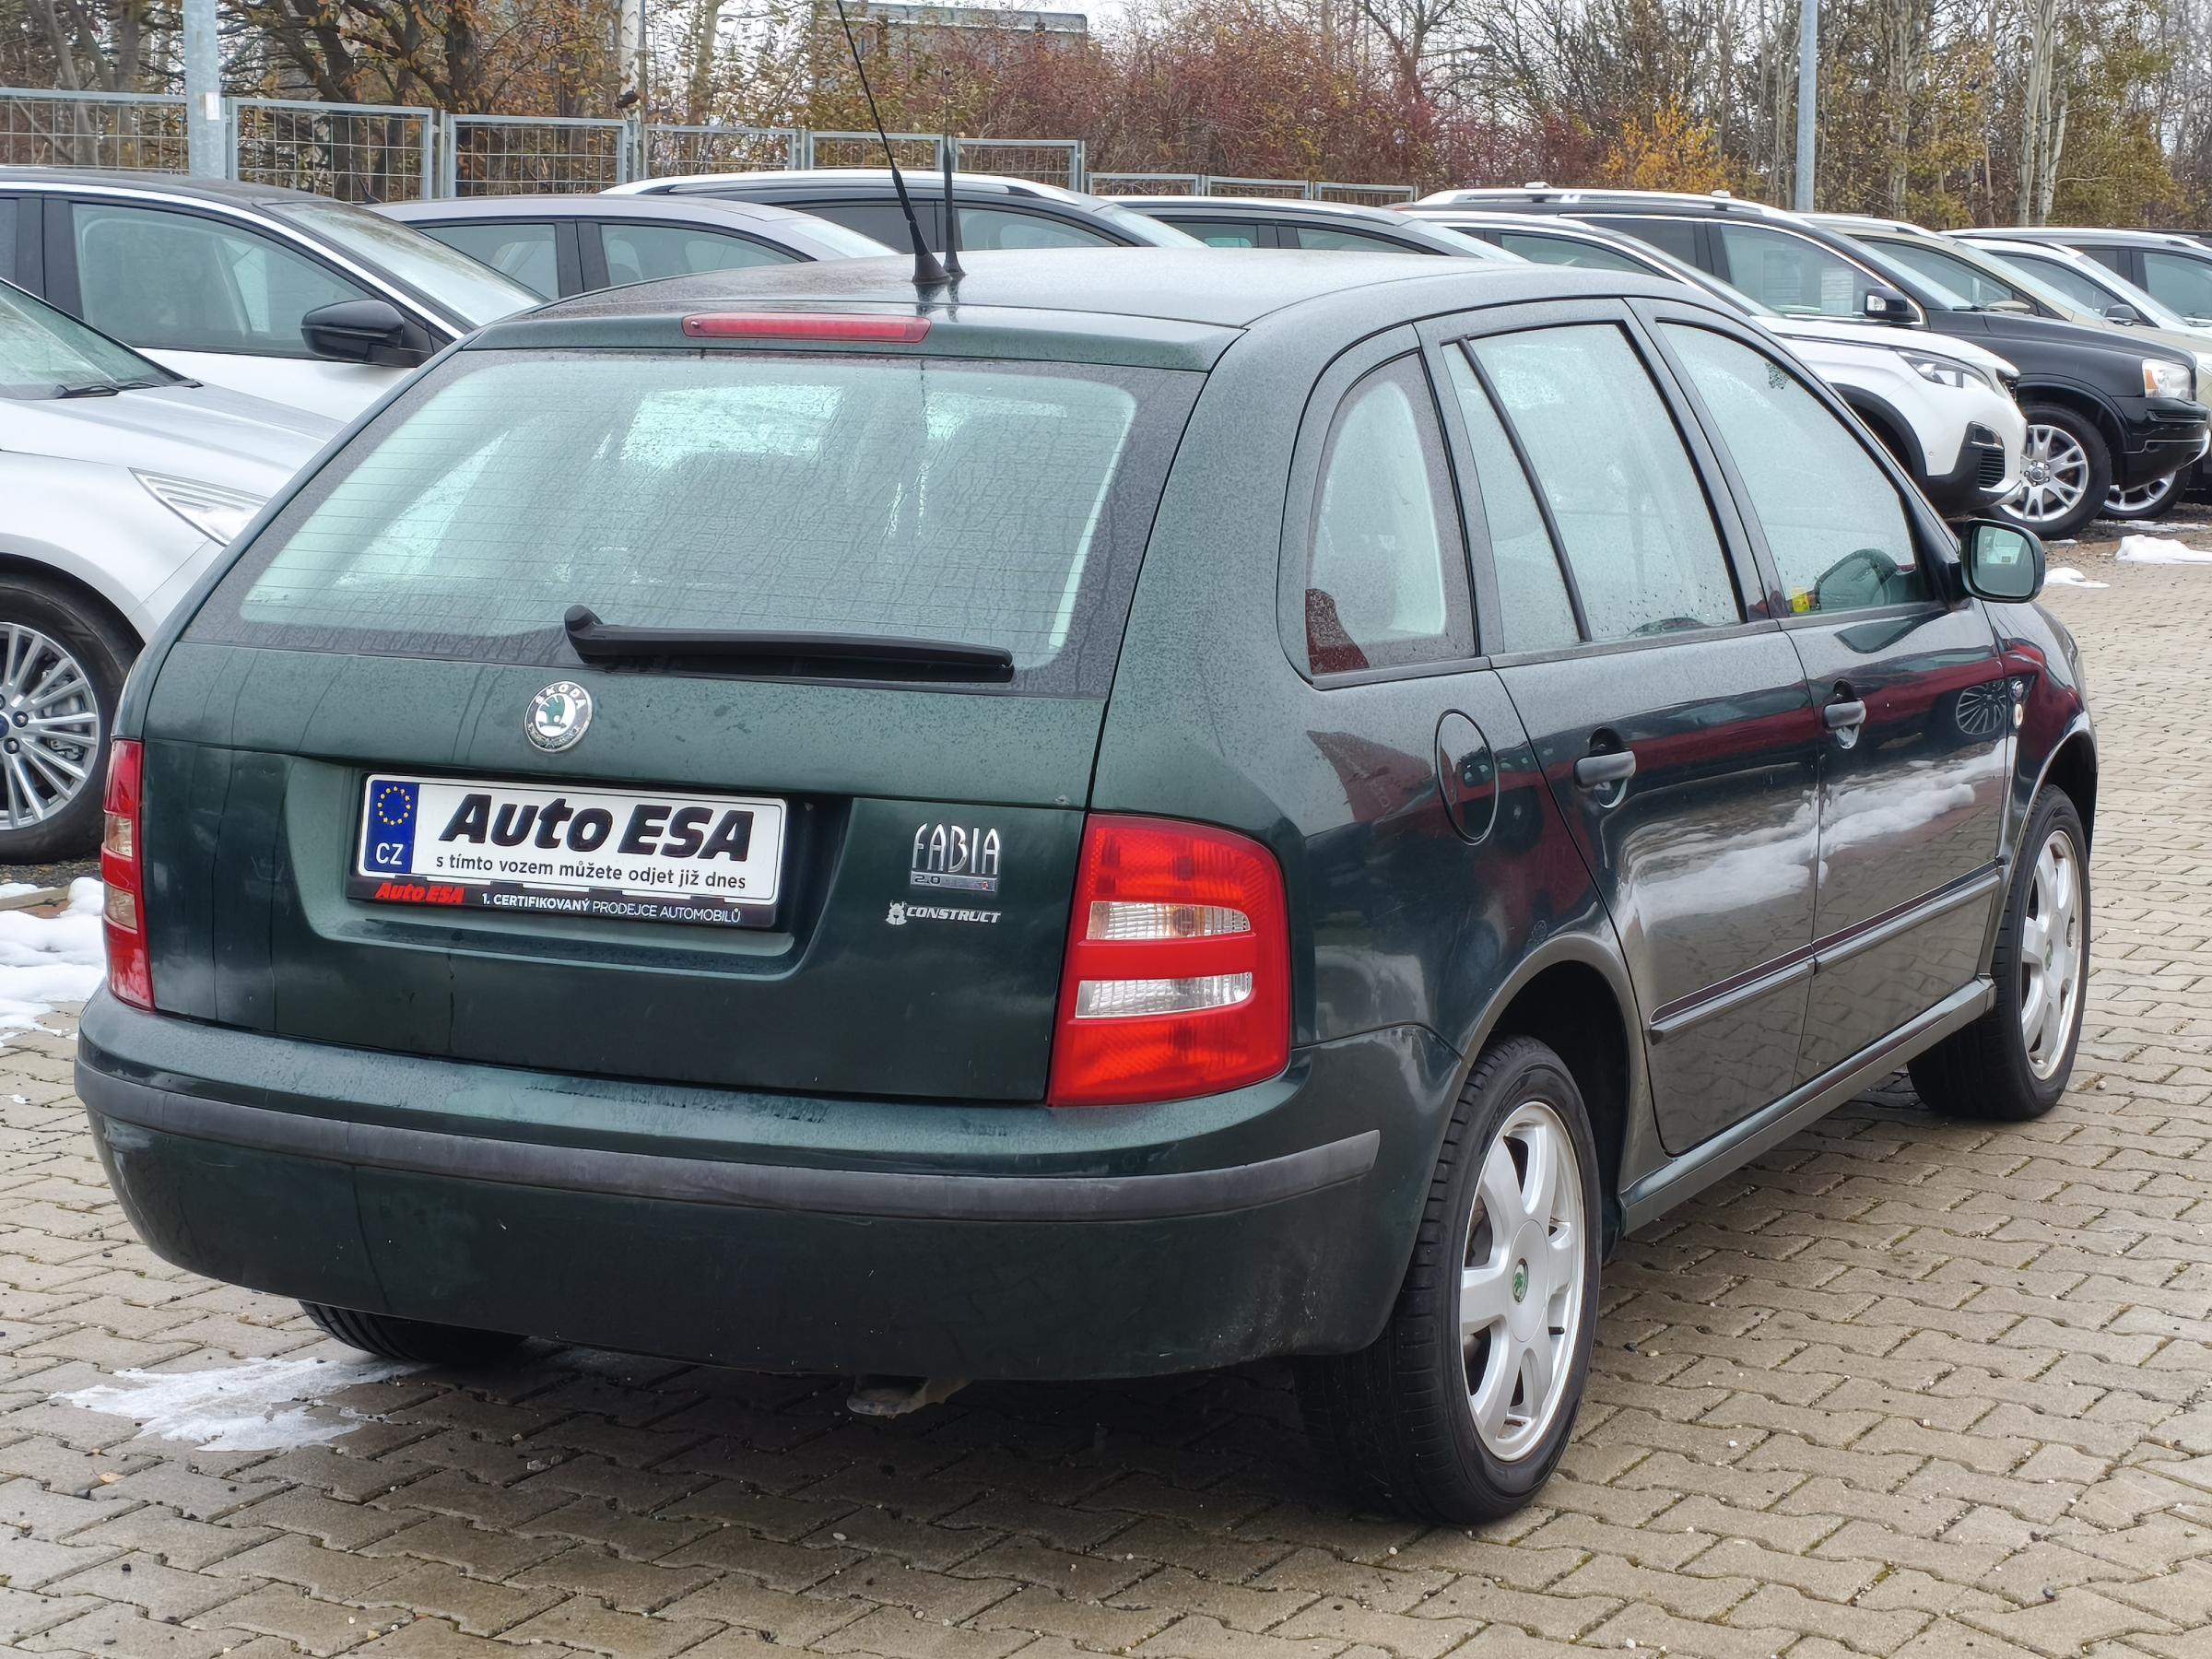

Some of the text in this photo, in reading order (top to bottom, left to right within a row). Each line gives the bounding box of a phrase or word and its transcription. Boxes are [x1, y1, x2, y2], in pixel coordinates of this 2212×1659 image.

[438, 794, 754, 862] Auto ESA
[375, 842, 404, 865] CZ
[912, 823, 1000, 875] FABIA
[436, 853, 746, 889] s tímto vozem můžete odjet již dnes
[914, 876, 940, 885] 2.0
[375, 882, 465, 905] Auto ESA
[482, 893, 740, 923] 1. CERTIFIKOVANÝ PRODEJCE AUTOMOBILŮ
[906, 906, 1002, 924] CONSTRUCT
